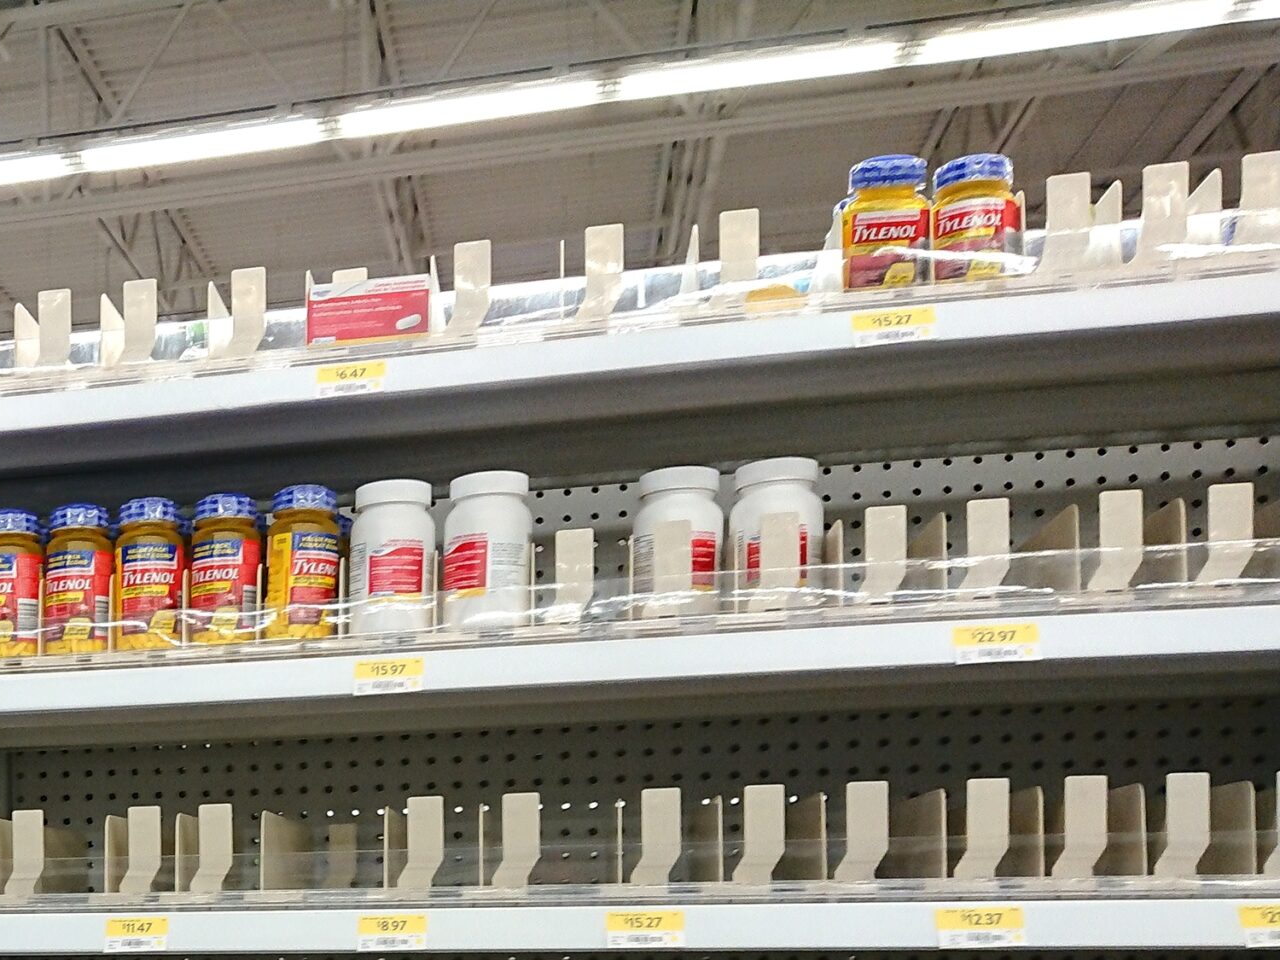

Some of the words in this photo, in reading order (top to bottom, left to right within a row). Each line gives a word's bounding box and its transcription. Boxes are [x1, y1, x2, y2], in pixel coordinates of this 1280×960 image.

[937, 209, 1001, 237] TYLENOL
[852, 224, 917, 243] TYLENOL
[123, 571, 175, 586] TYLENOL
